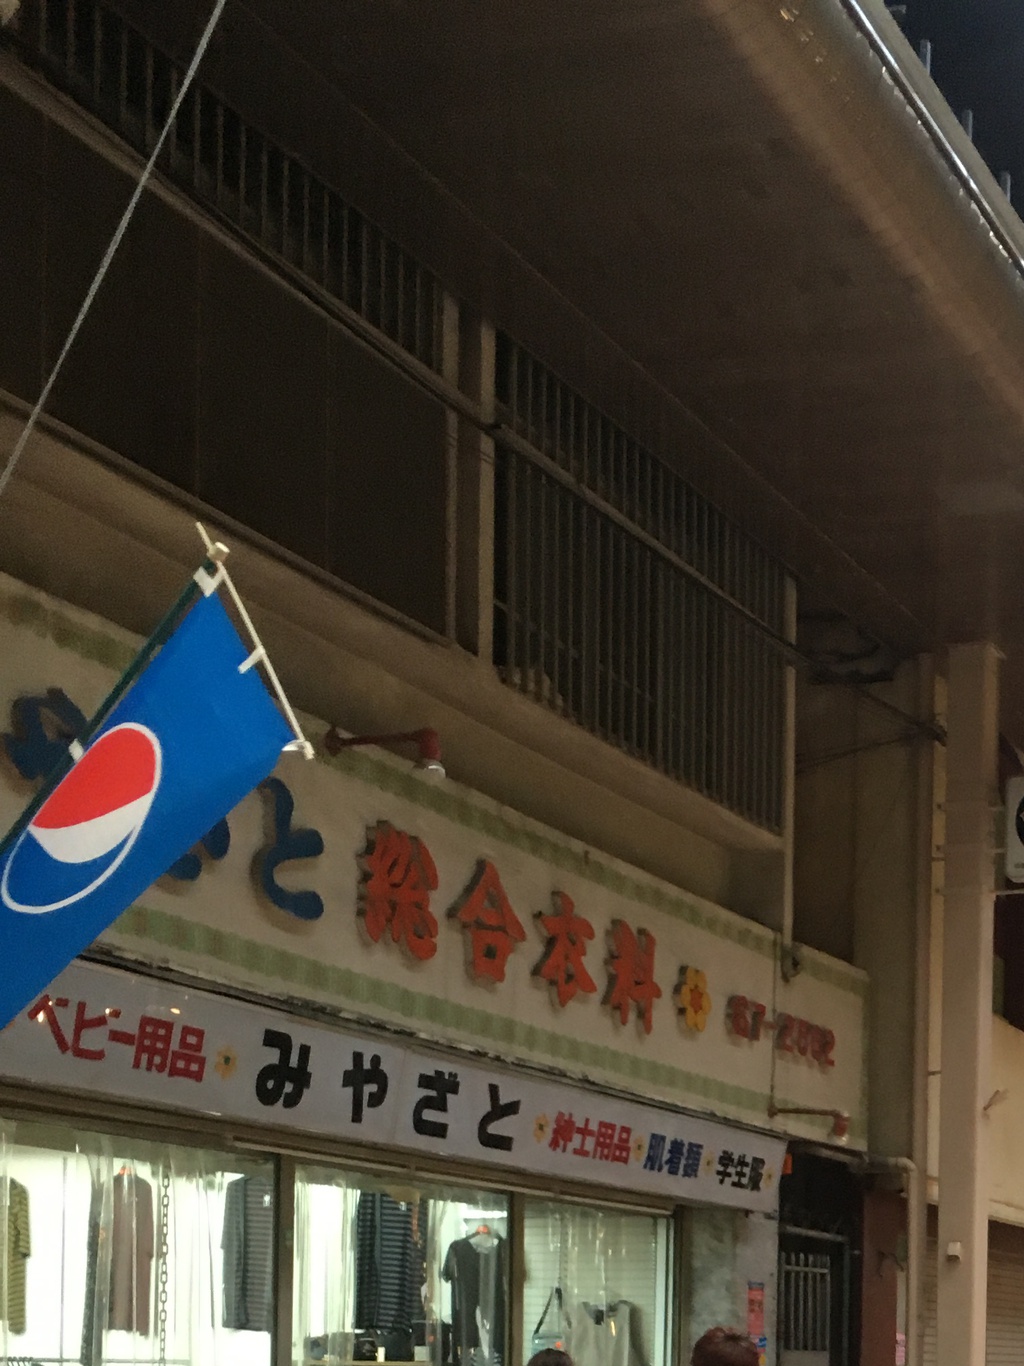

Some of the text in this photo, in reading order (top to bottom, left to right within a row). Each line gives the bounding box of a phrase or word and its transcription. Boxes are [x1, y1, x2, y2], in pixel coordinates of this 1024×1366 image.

[27, 994, 206, 1083] ベビー用品
[256, 1028, 521, 1151] みやざと
[549, 1110, 632, 1166] 紳士用品
[716, 1150, 766, 1192] 学生服
